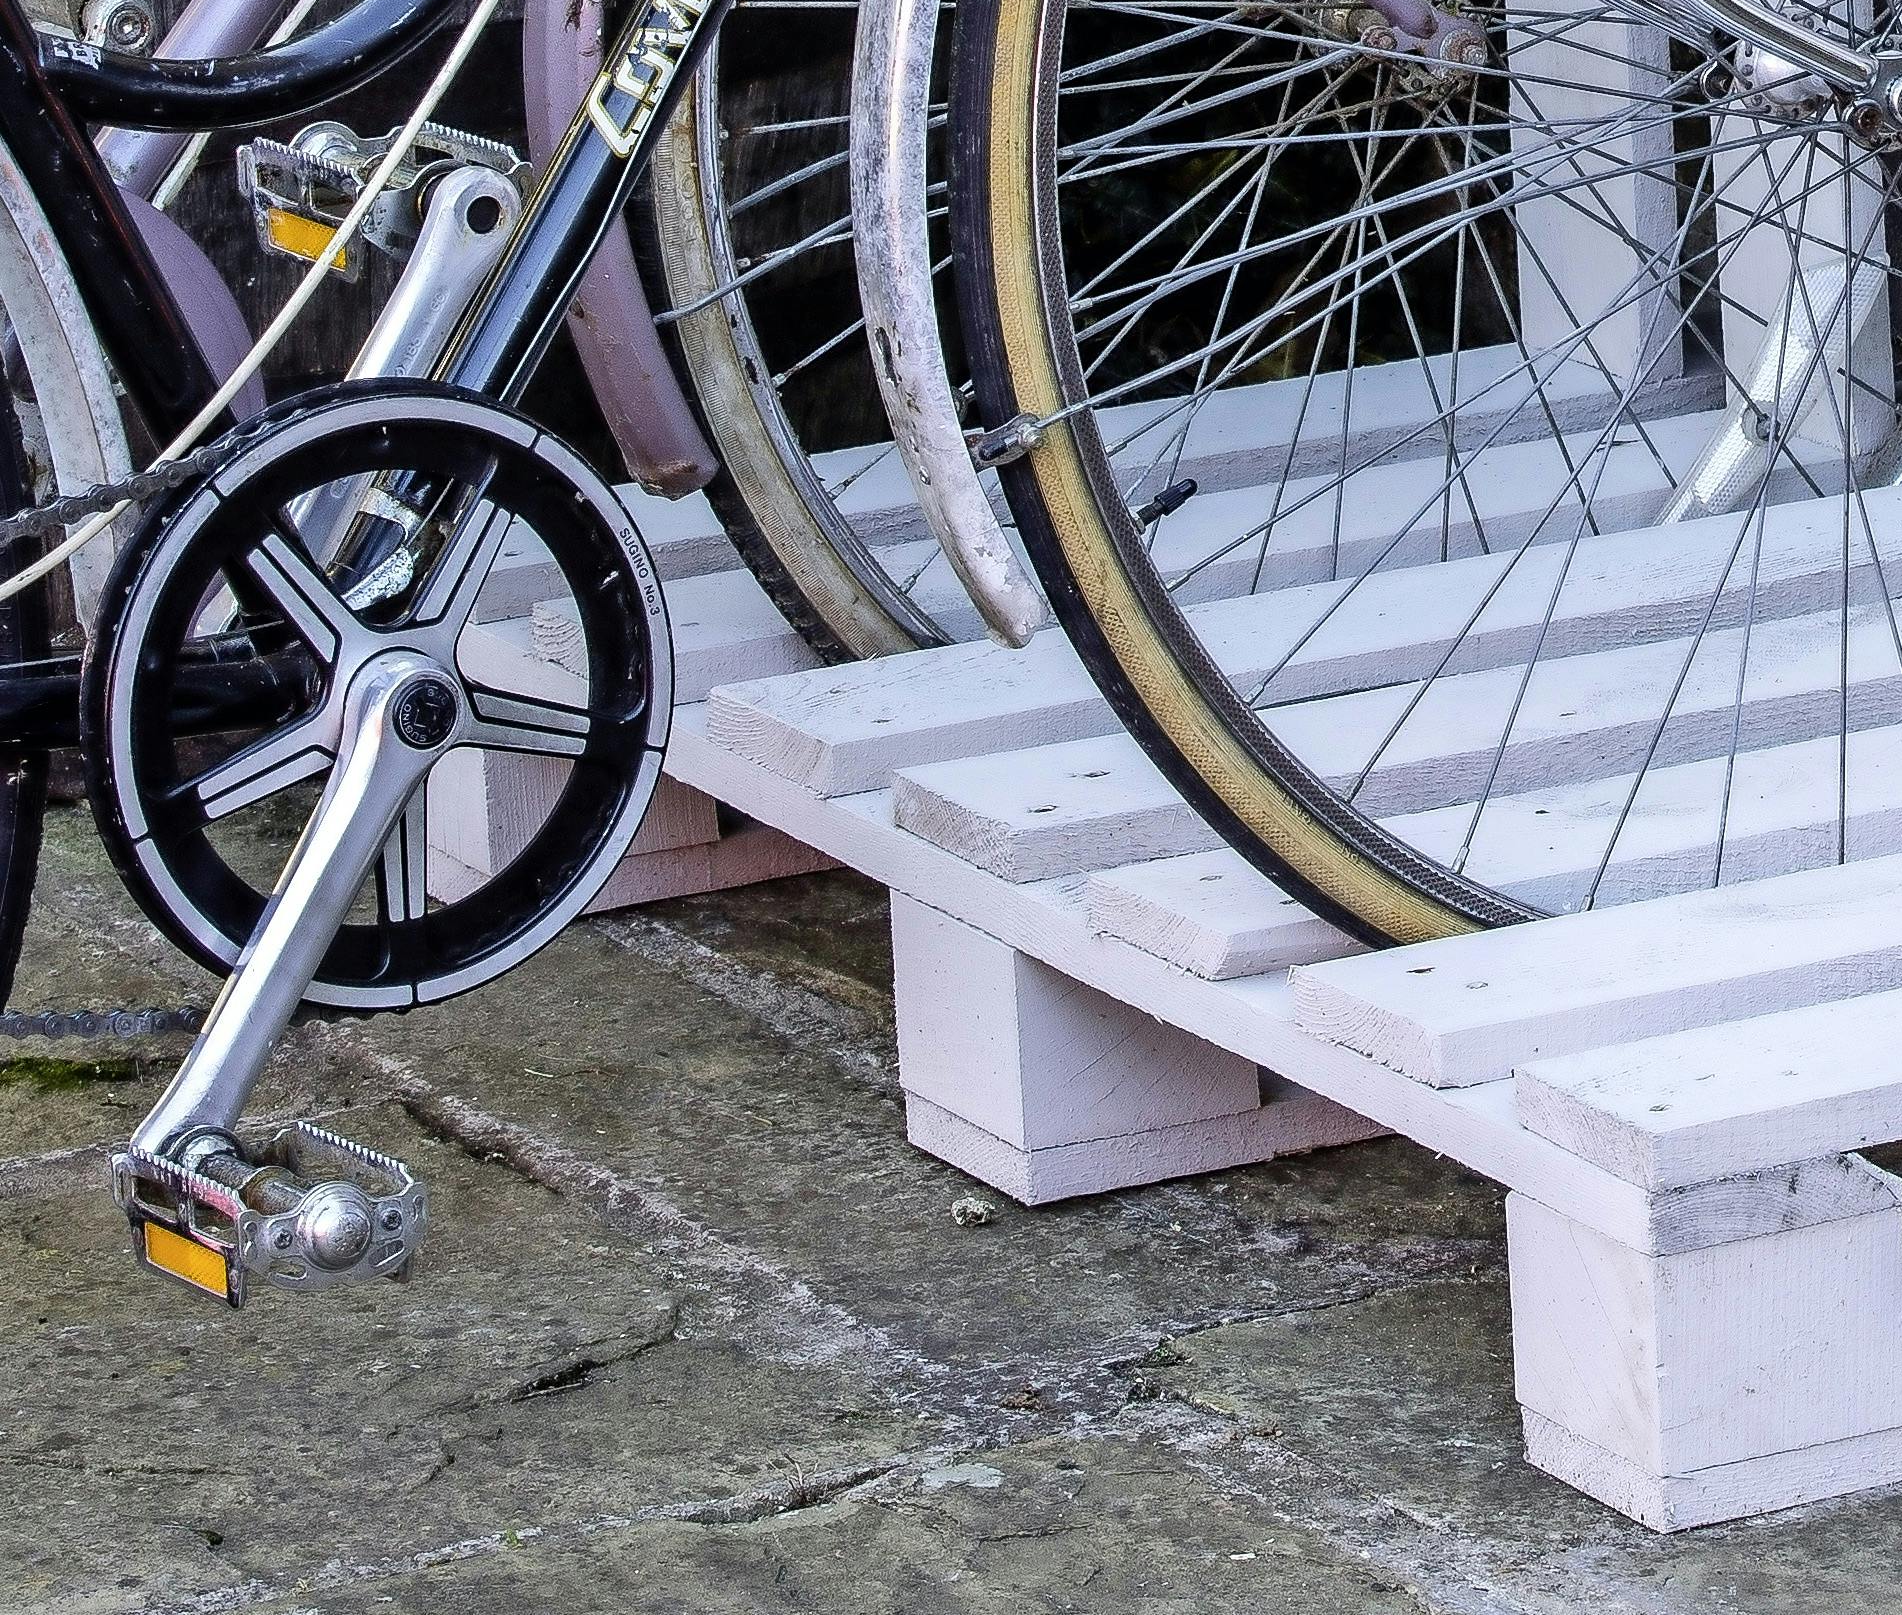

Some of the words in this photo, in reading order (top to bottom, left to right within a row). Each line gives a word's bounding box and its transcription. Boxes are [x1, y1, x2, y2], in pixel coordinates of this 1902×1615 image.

[619, 527, 649, 579] SUGINO
[643, 584, 661, 616] No.3
[402, 703, 427, 742] SUGINO
